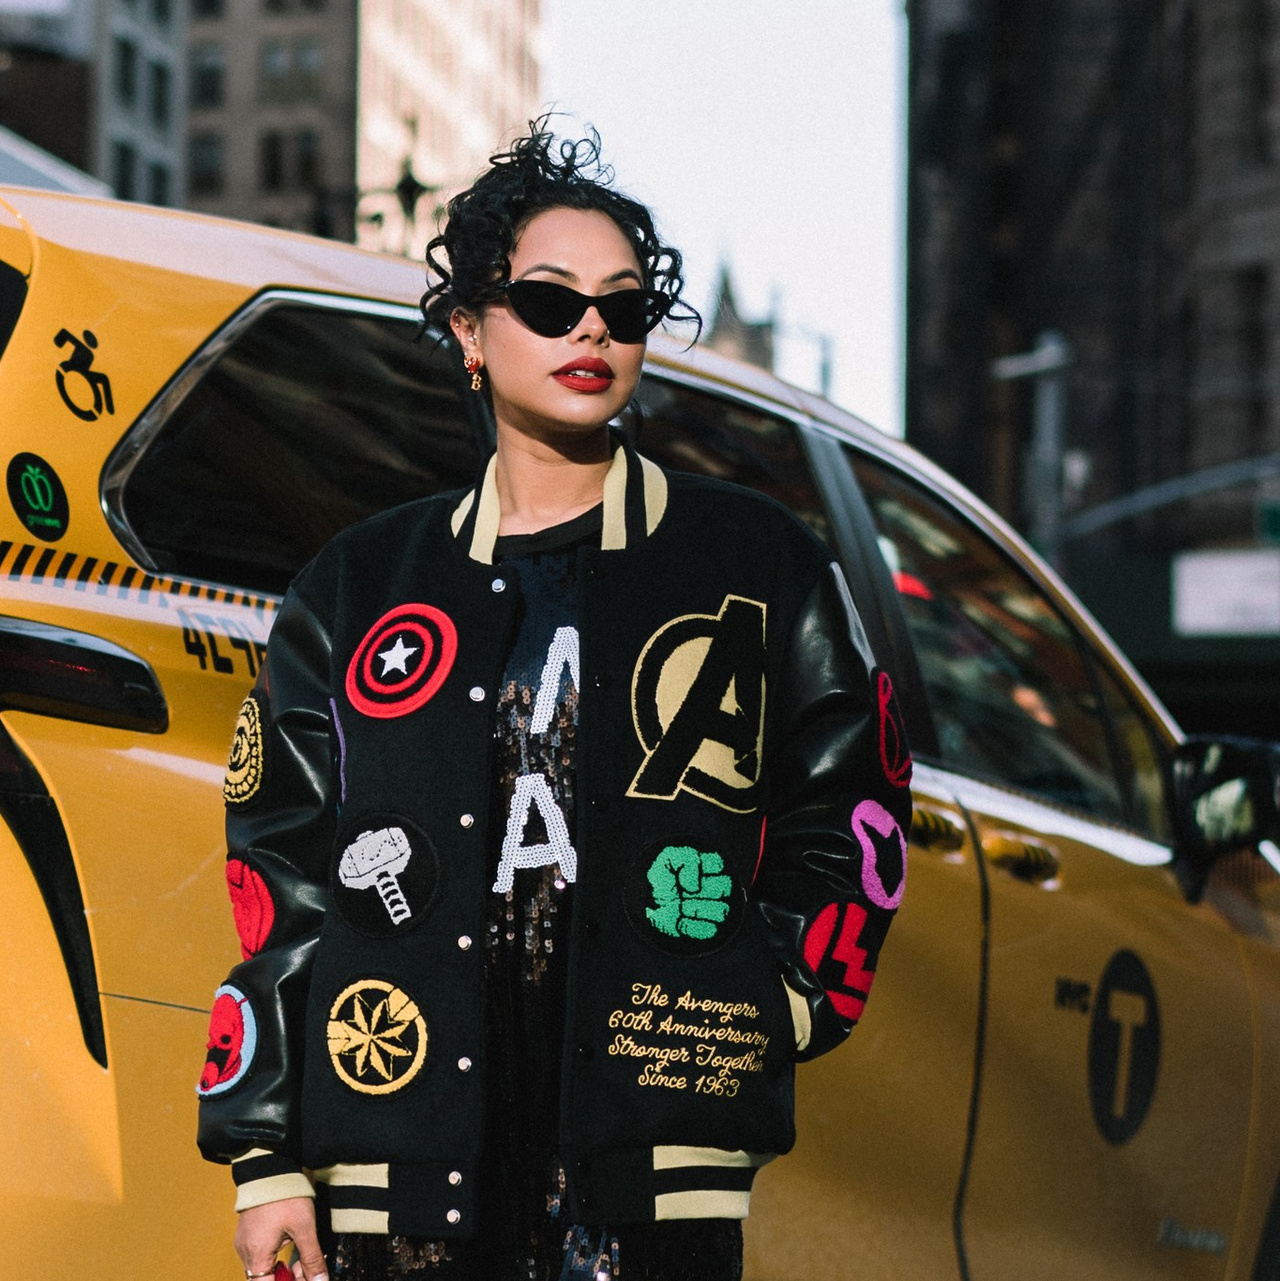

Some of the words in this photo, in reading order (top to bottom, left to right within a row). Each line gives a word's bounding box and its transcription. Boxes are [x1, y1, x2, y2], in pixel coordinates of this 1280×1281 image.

[631, 983, 669, 1007] The
[675, 990, 760, 1023] Avengers
[608, 1010, 653, 1031] 60th
[656, 1015, 769, 1055] Anniversary
[608, 1034, 690, 1072] Stronger
[638, 1064, 688, 1089] Since
[695, 1075, 740, 1097] 1963
